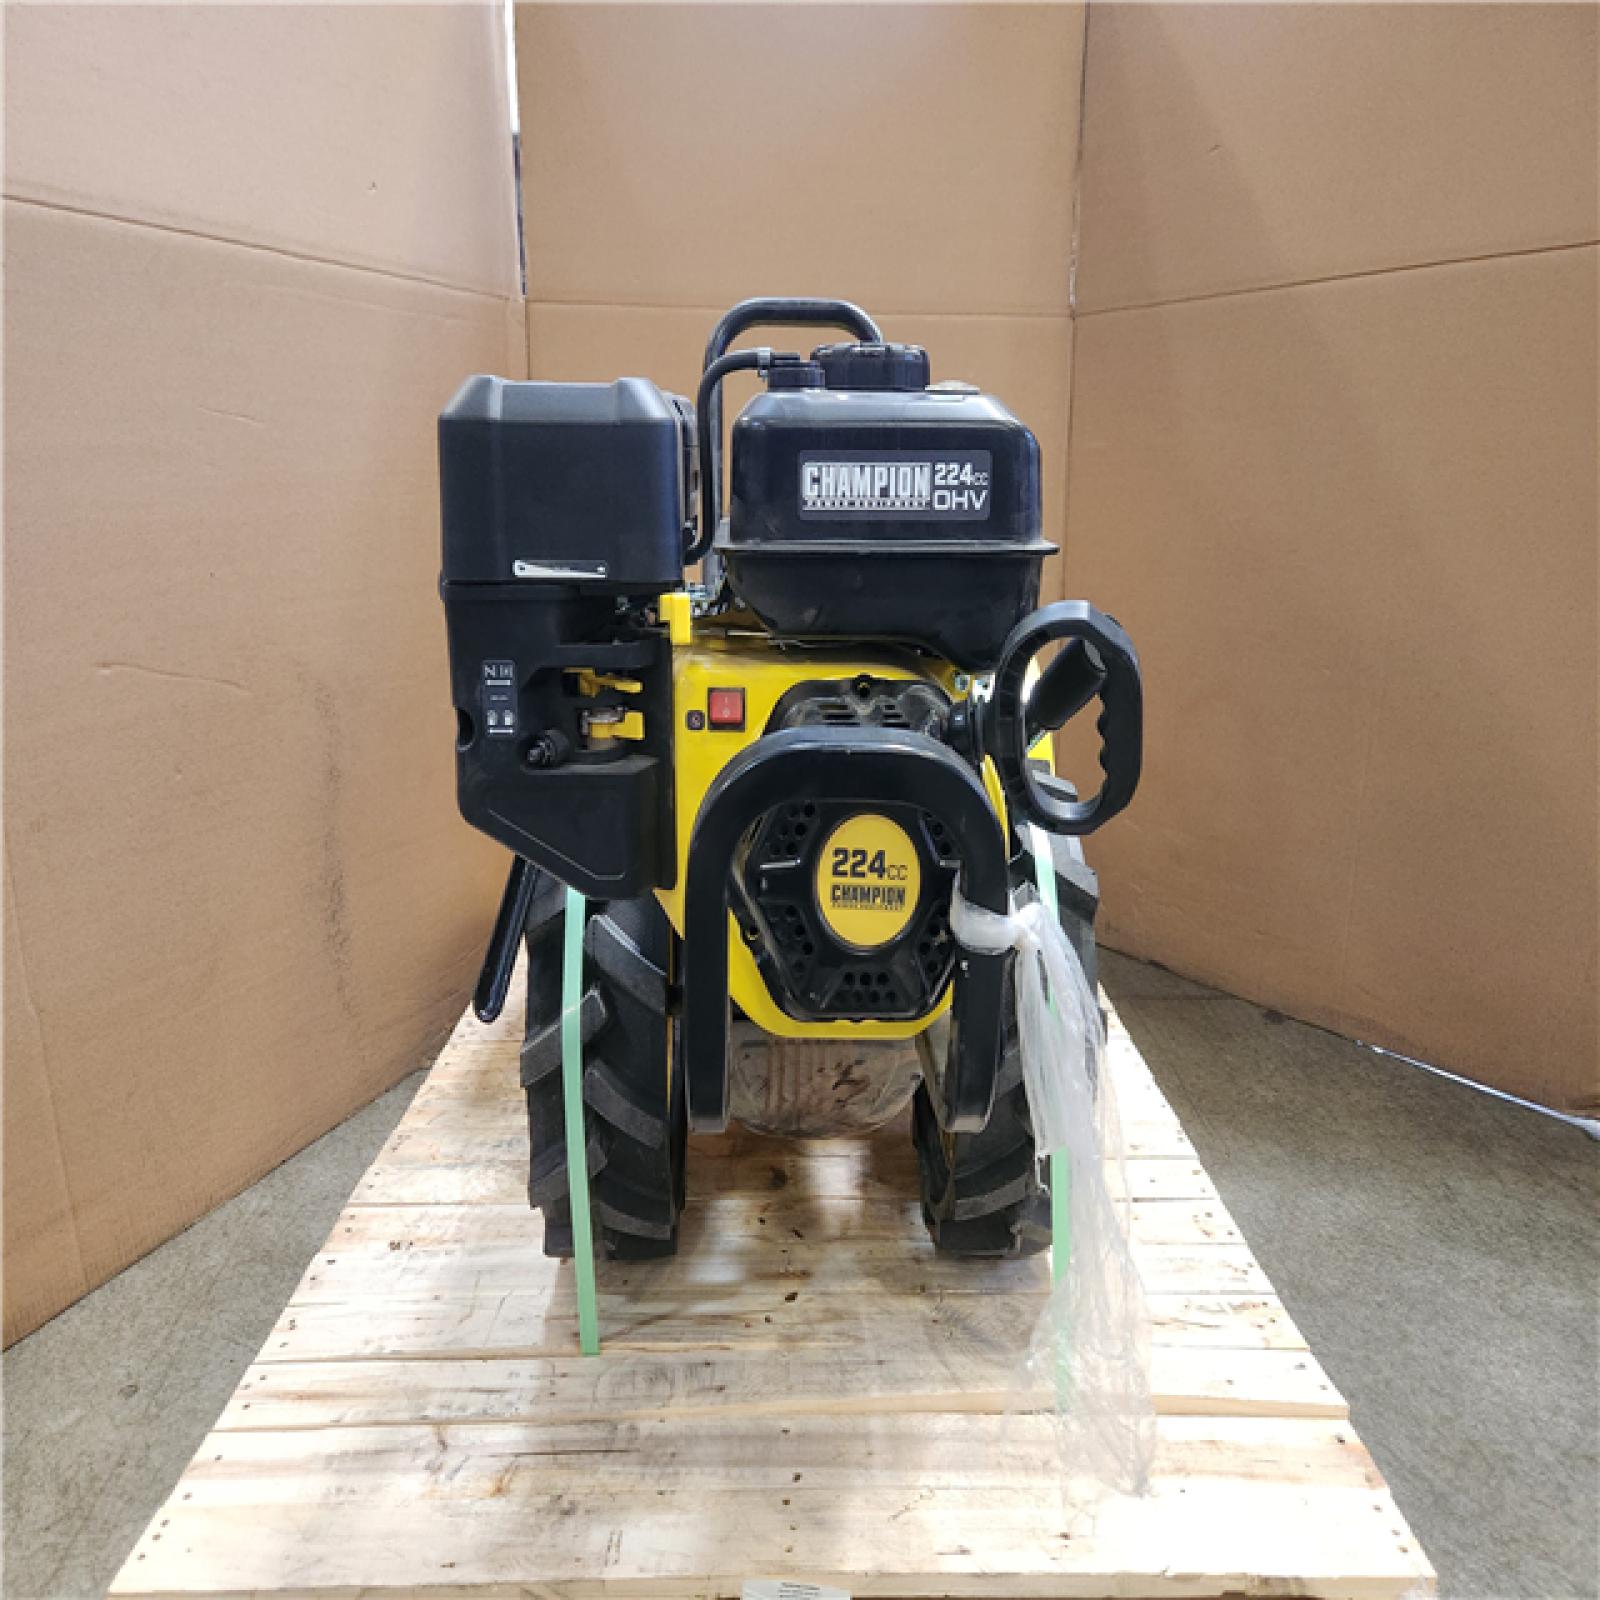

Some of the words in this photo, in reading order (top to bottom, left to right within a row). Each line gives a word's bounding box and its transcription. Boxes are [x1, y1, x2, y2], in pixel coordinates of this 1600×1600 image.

[804, 463, 931, 499] CHAMPION
[934, 489, 988, 511] OHV
[831, 884, 906, 905] CHAMPION
